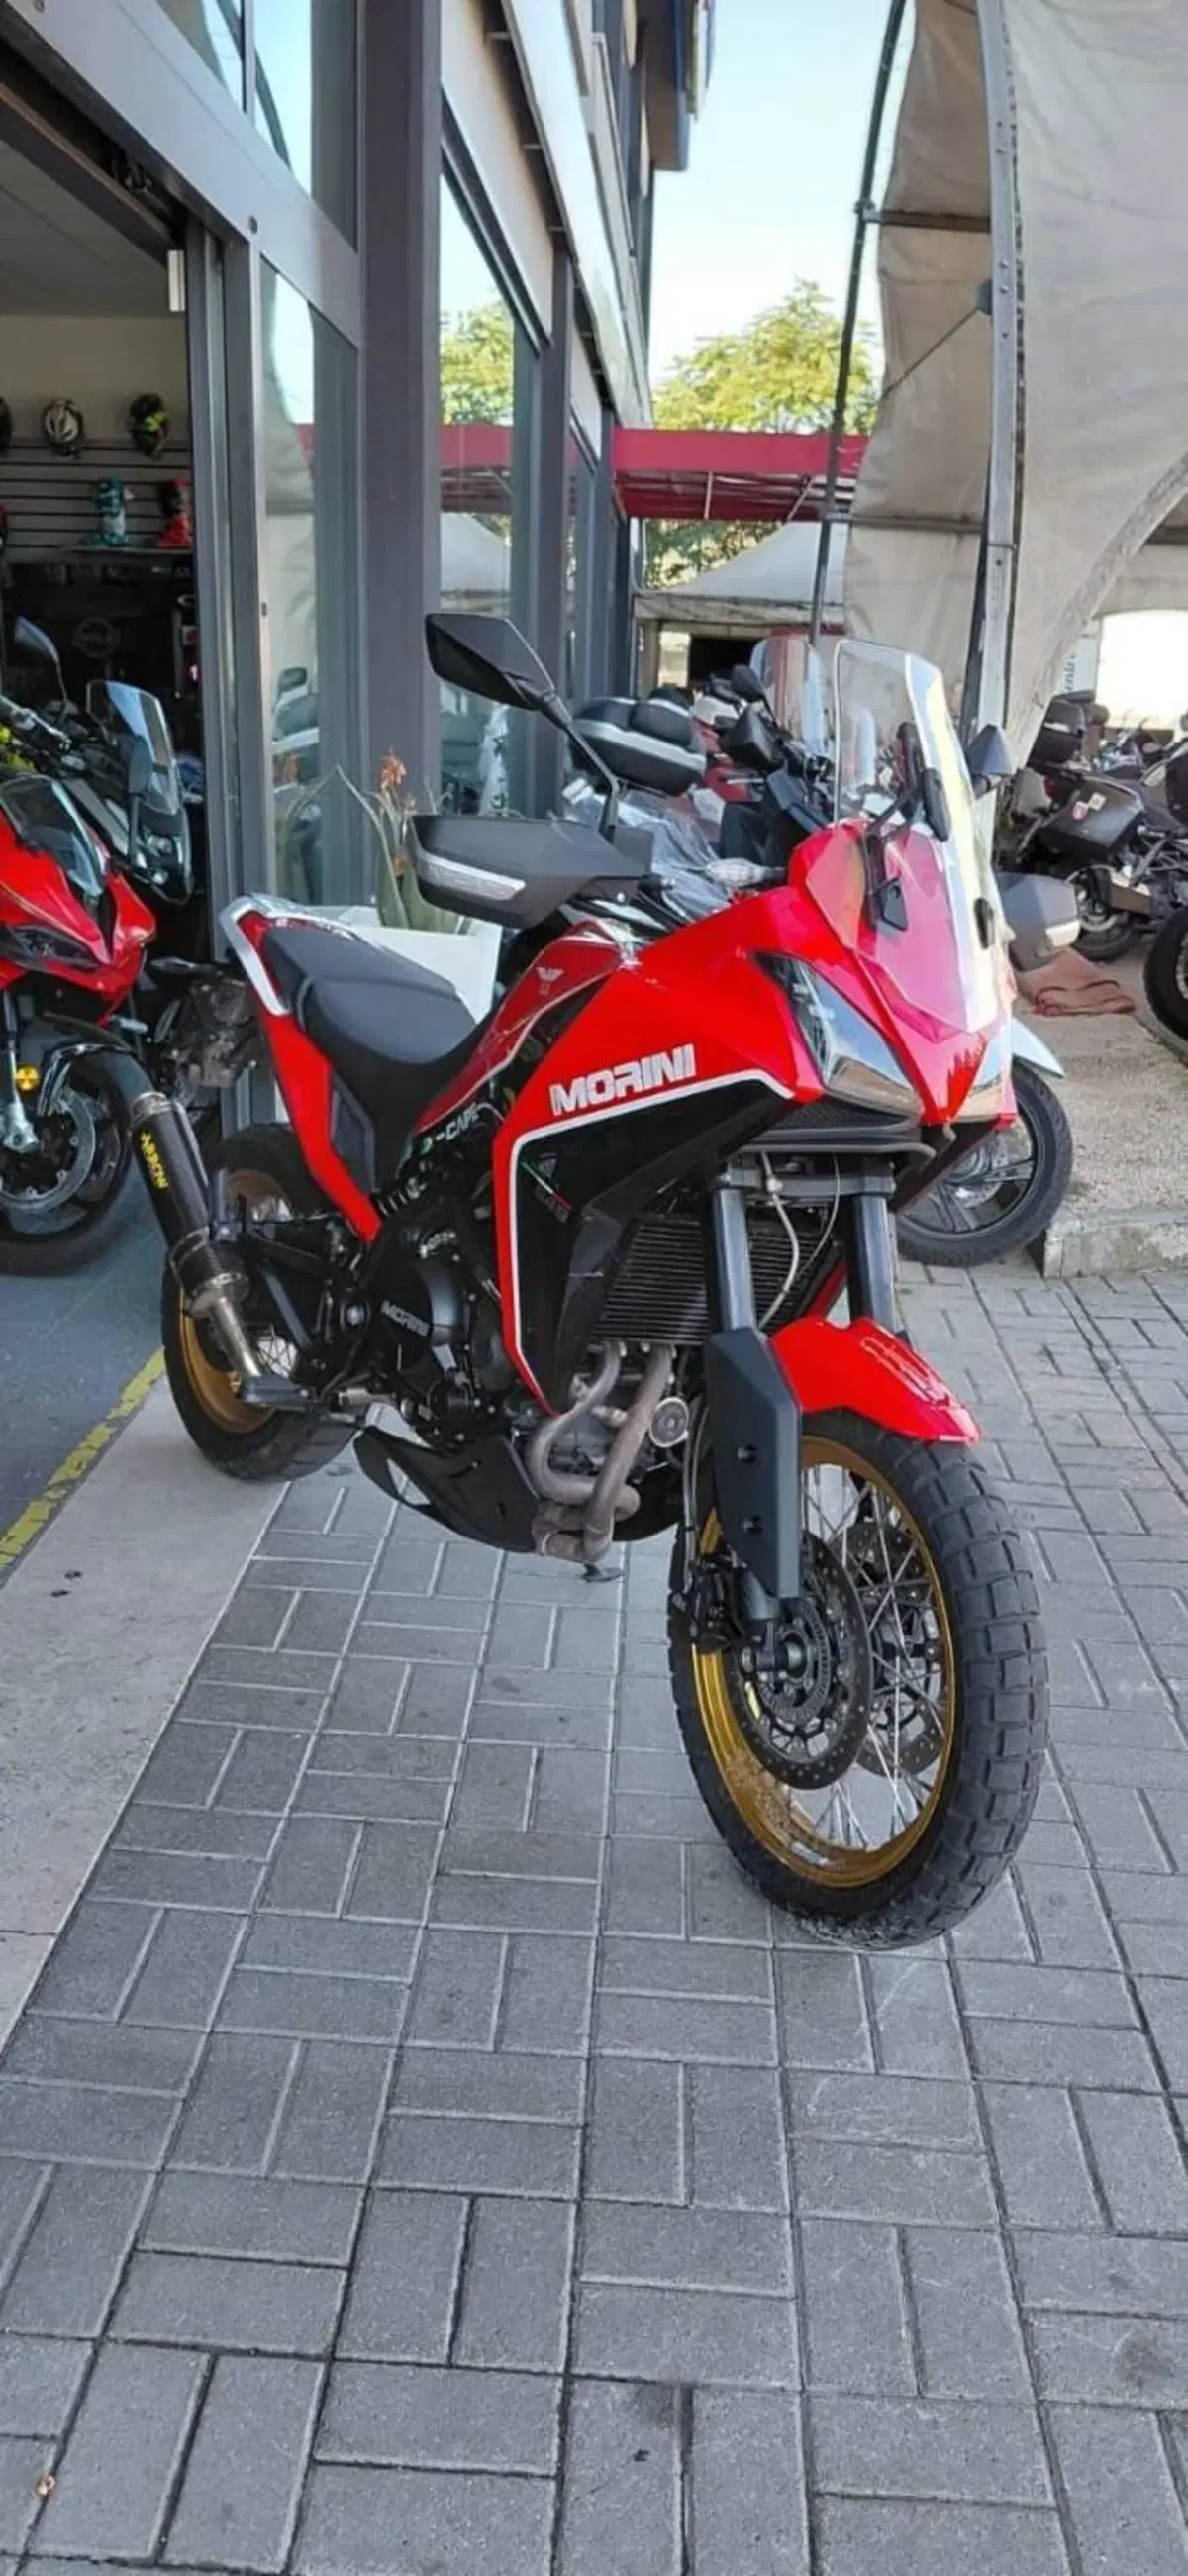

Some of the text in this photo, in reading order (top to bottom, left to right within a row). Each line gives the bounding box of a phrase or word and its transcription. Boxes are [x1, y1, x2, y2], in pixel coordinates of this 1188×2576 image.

[549, 1043, 696, 1116] MORINI
[141, 1132, 169, 1188] ARROW
[380, 1300, 430, 1337] MORINI
